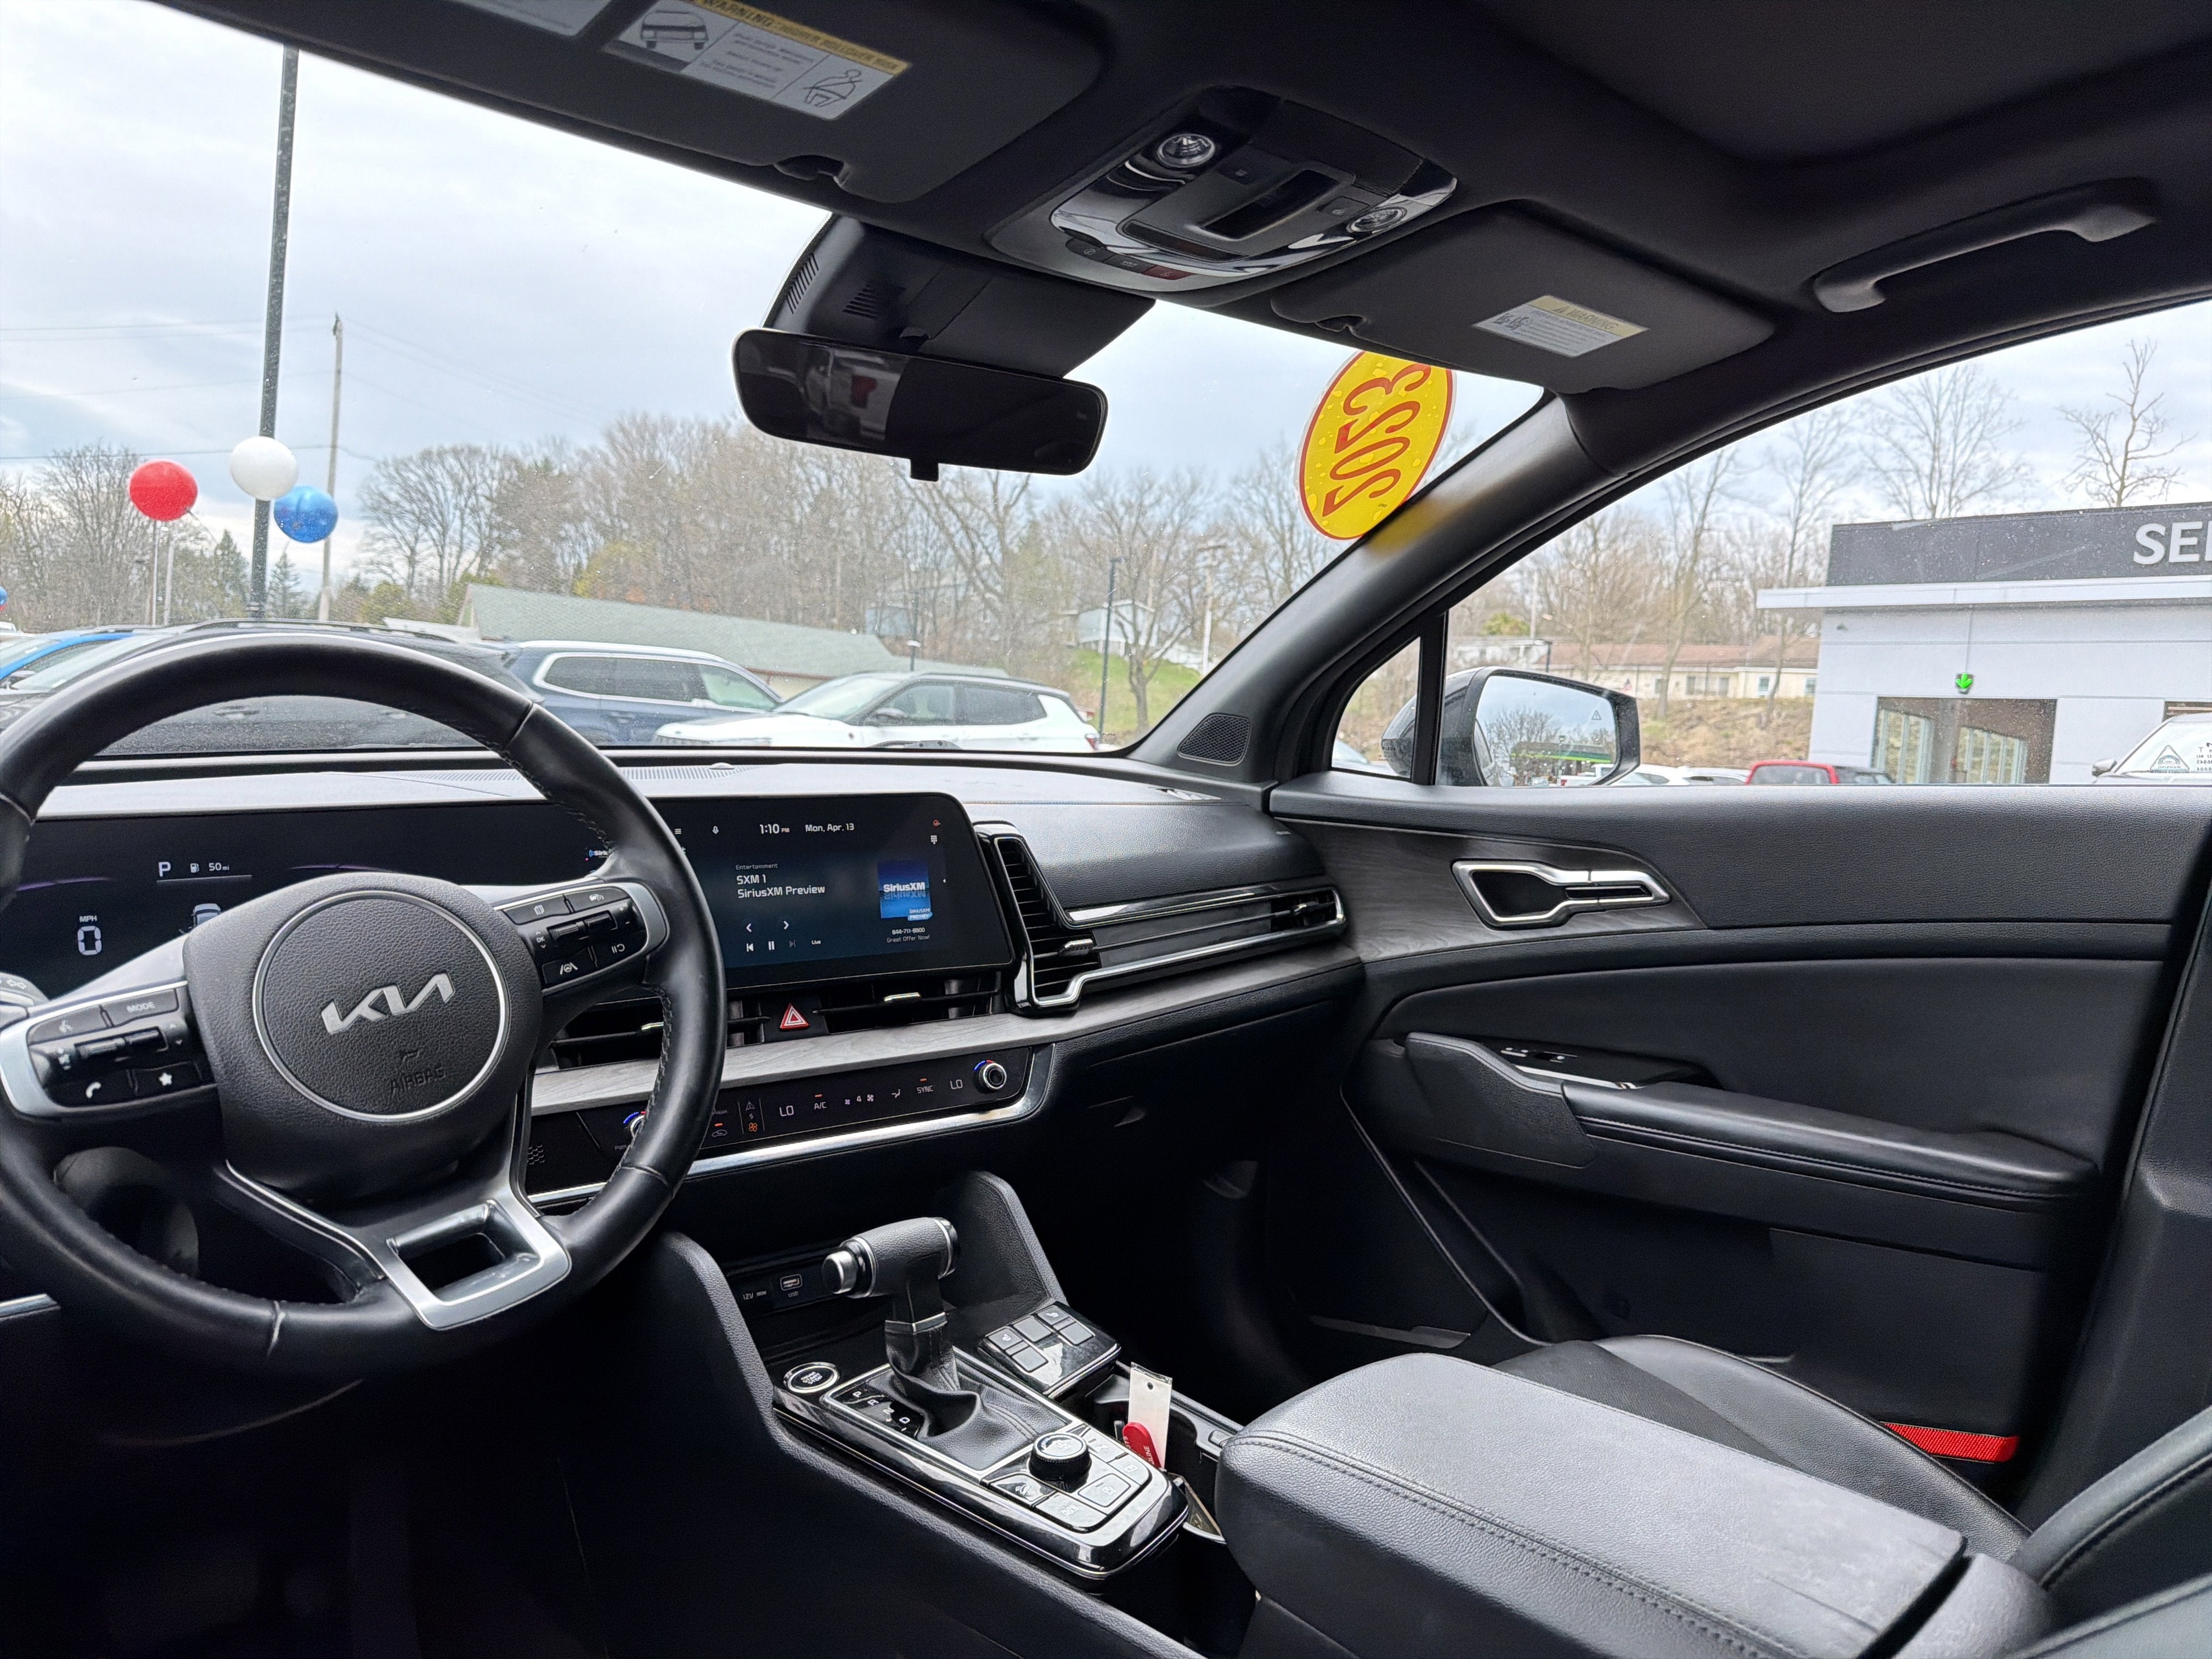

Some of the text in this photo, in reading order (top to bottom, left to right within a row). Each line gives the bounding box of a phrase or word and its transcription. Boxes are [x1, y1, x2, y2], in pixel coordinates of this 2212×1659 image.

[2133, 521, 2212, 565] SE
[759, 823, 780, 834] 1:10
[845, 823, 855, 831] 13
[158, 861, 171, 877] P
[736, 874, 767, 885] SXM 1
[737, 885, 826, 899] SiriusXM Preview
[883, 882, 926, 893] SiriusXM
[77, 925, 102, 956] 0
[126, 1001, 156, 1012] MODE
[321, 973, 455, 1034] KIA
[917, 1085, 934, 1094] SYNC
[950, 1079, 963, 1090] LO
[779, 1105, 794, 1117] LO
[814, 1102, 827, 1110] A/C
[742, 1292, 754, 1300] 12V
